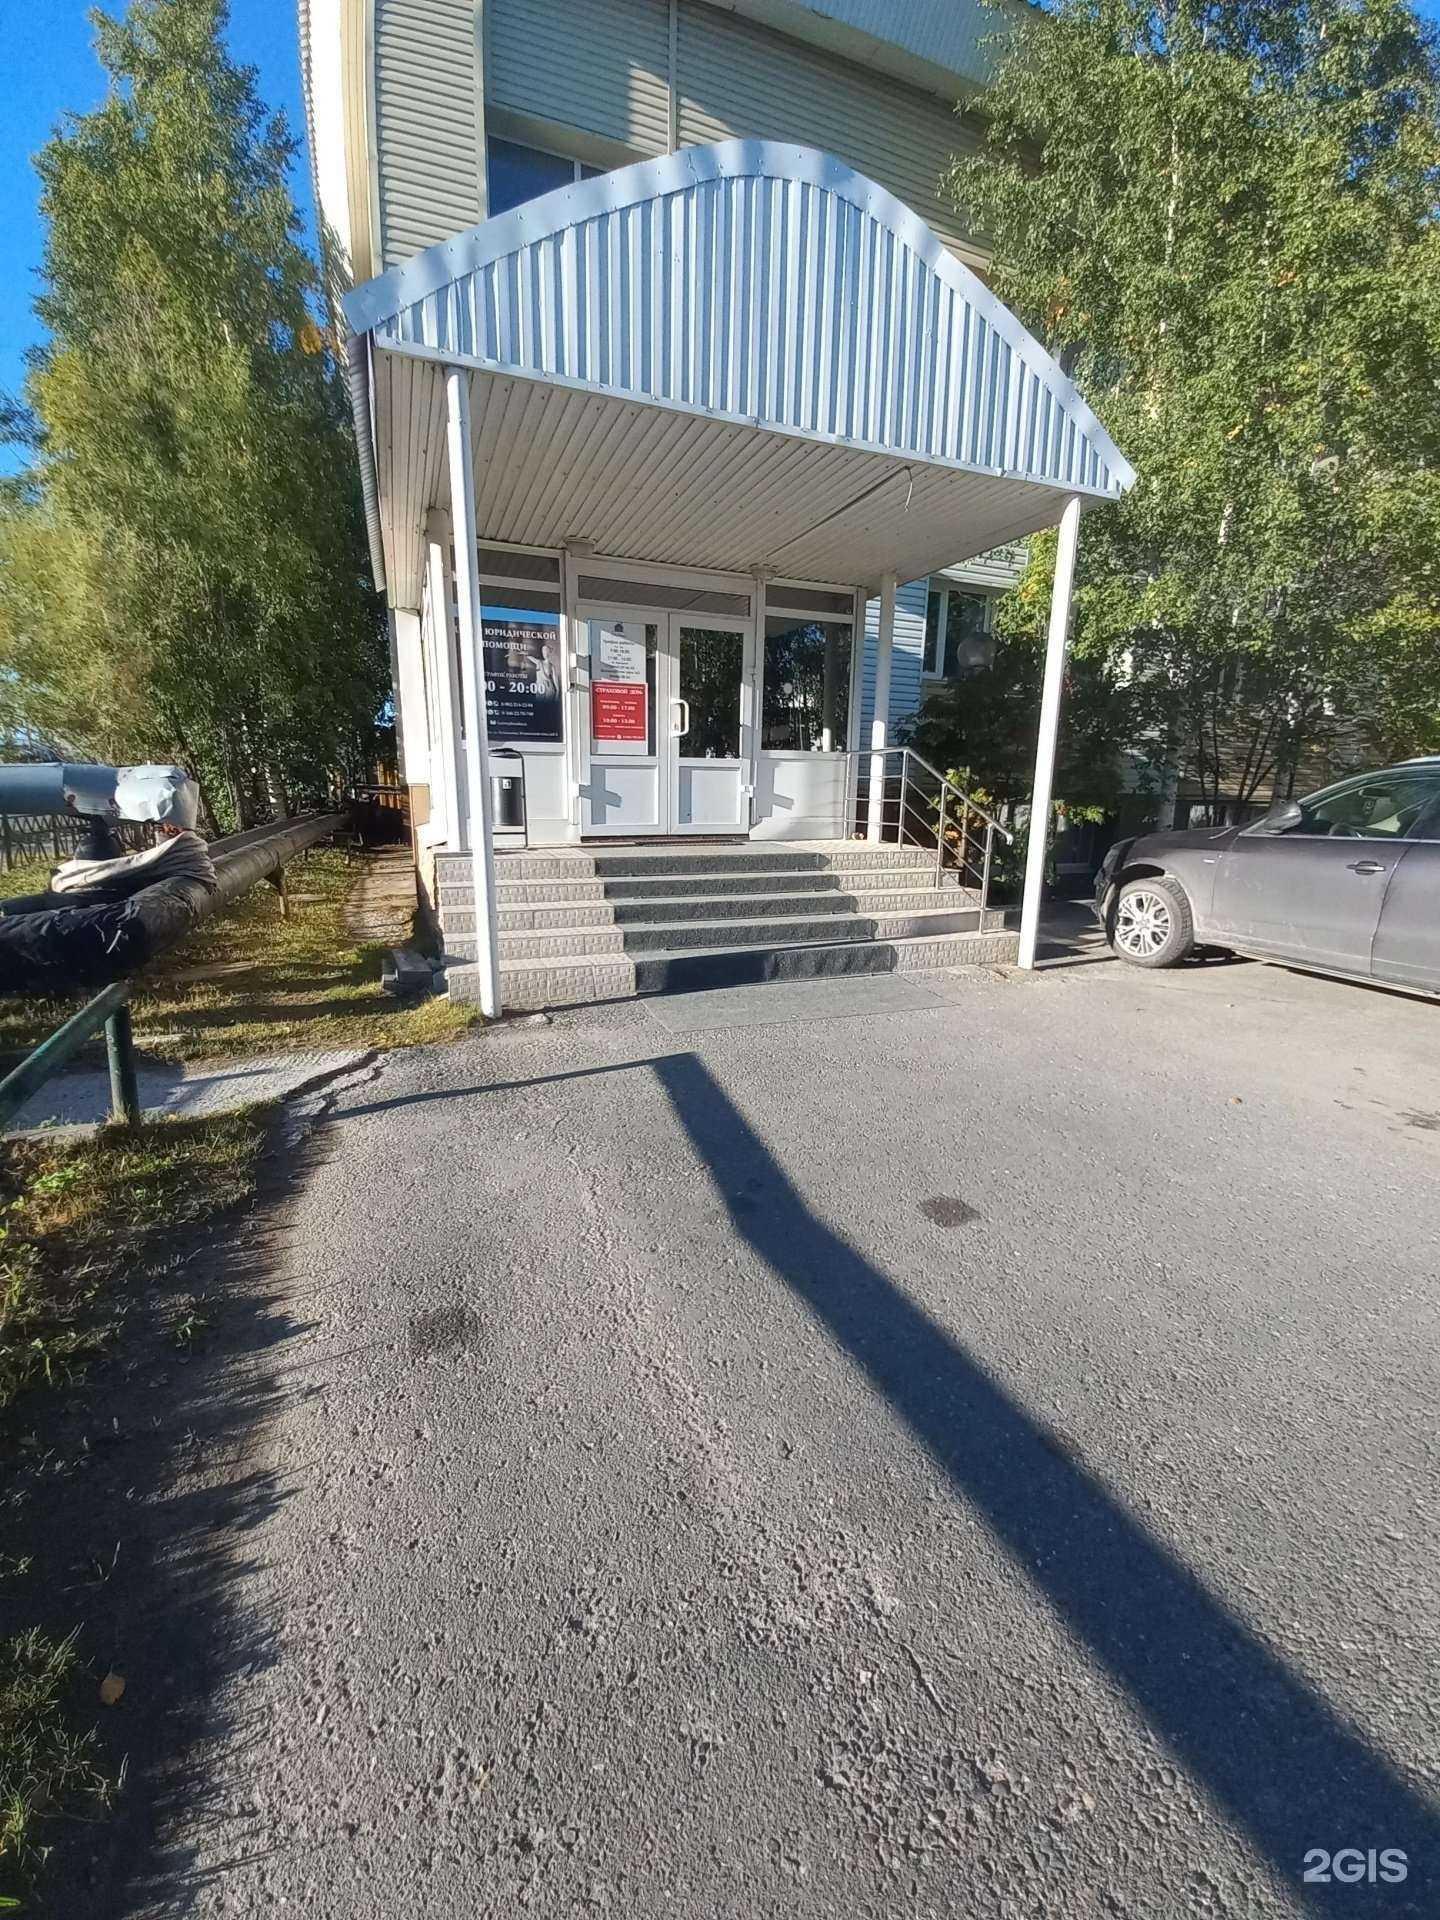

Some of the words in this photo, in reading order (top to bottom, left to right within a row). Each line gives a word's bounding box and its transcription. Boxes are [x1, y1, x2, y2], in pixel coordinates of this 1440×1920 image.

[485, 627, 556, 641] ЮРИДИЧЕСКОЙ
[482, 640, 528, 652] ПОМОЩИ
[508, 681, 546, 695] 20:00
